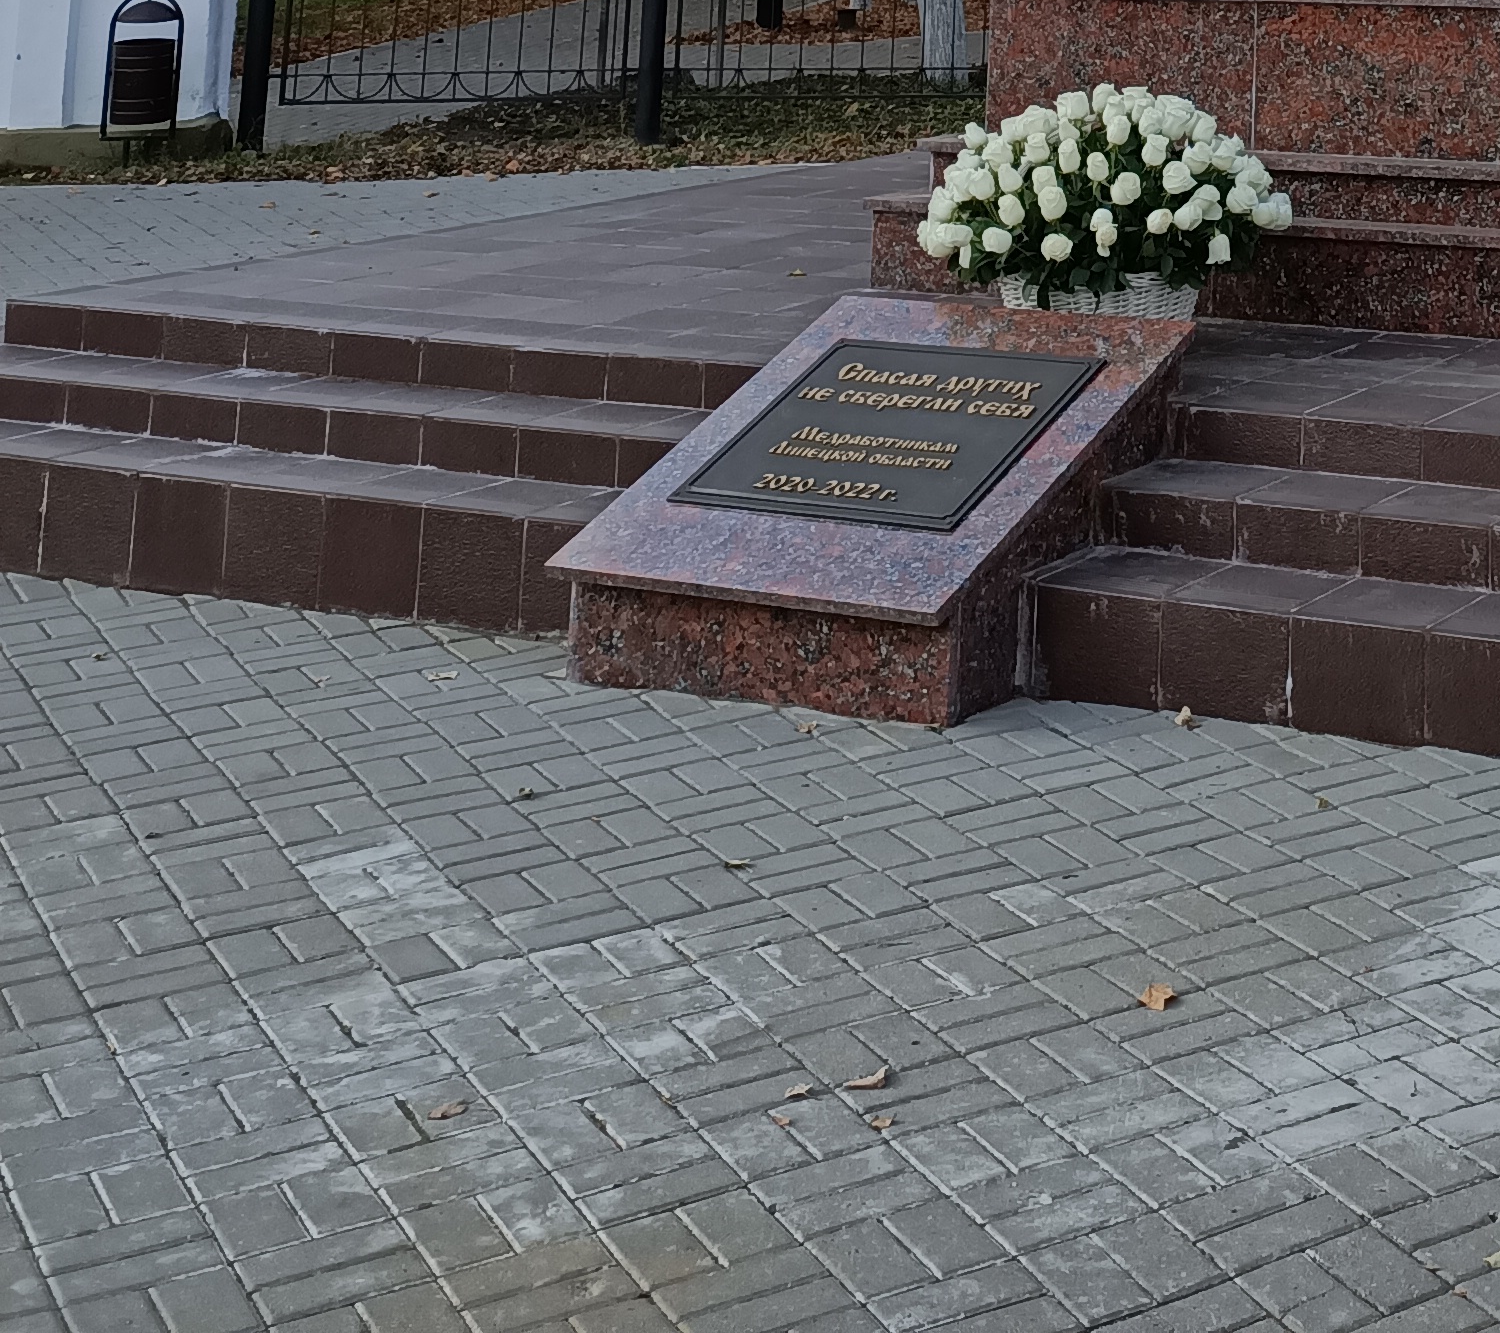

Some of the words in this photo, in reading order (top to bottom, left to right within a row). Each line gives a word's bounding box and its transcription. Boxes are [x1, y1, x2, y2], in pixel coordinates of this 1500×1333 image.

[838, 362, 937, 387] Спасая
[936, 374, 1042, 400] других
[838, 389, 964, 413] сберегли
[967, 398, 1037, 420] себя
[791, 426, 959, 453] Медработникам
[768, 440, 865, 463] Липецкой
[868, 452, 953, 470] области
[753, 473, 881, 500] 2020-2022
